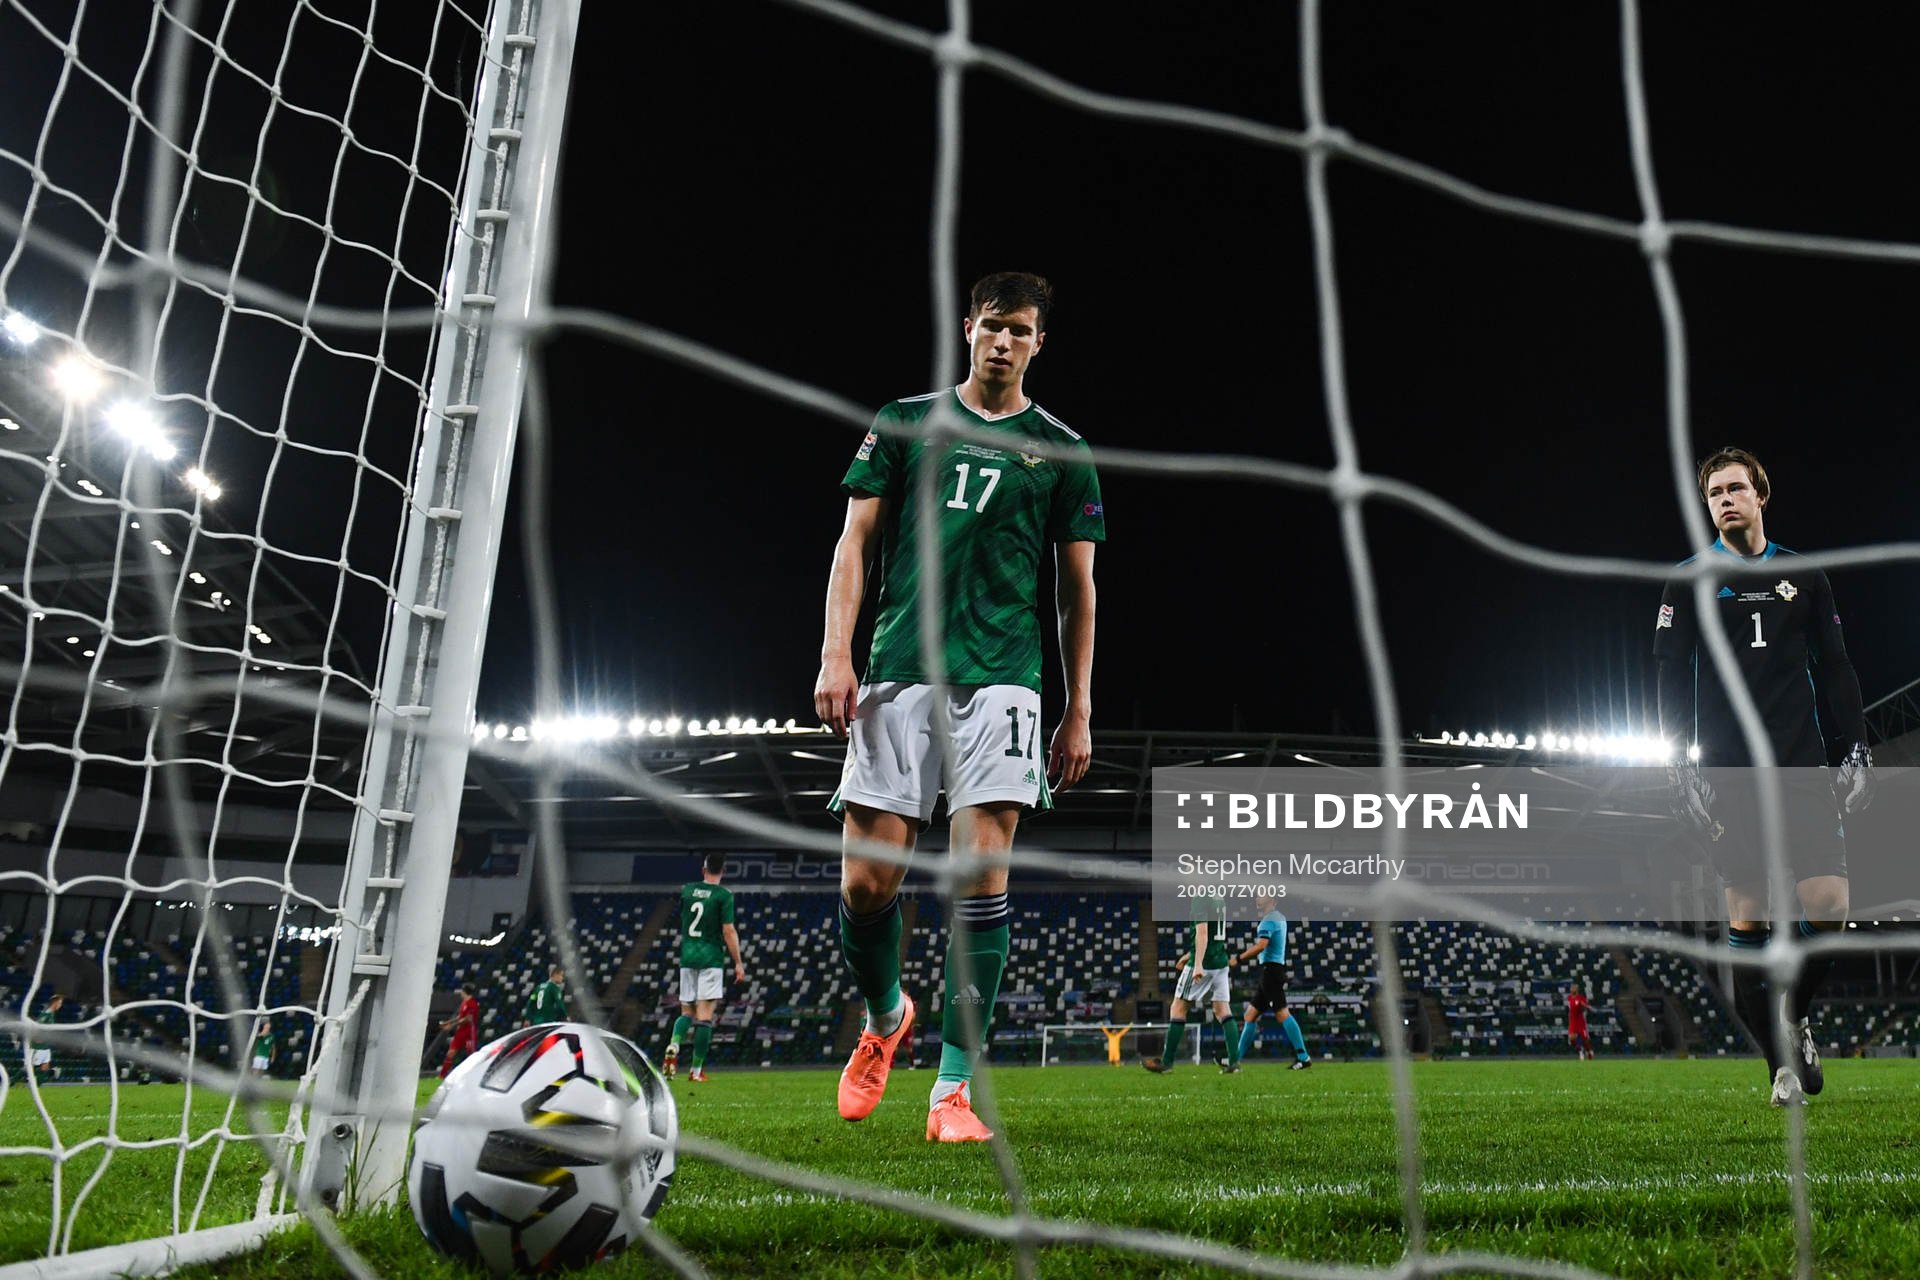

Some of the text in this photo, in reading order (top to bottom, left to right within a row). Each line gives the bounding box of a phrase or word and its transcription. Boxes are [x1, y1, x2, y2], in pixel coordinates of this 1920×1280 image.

[947, 463, 1001, 514] 17
[1751, 612, 1767, 648] 1
[1005, 706, 1037, 760] 17
[688, 901, 704, 938] 2
